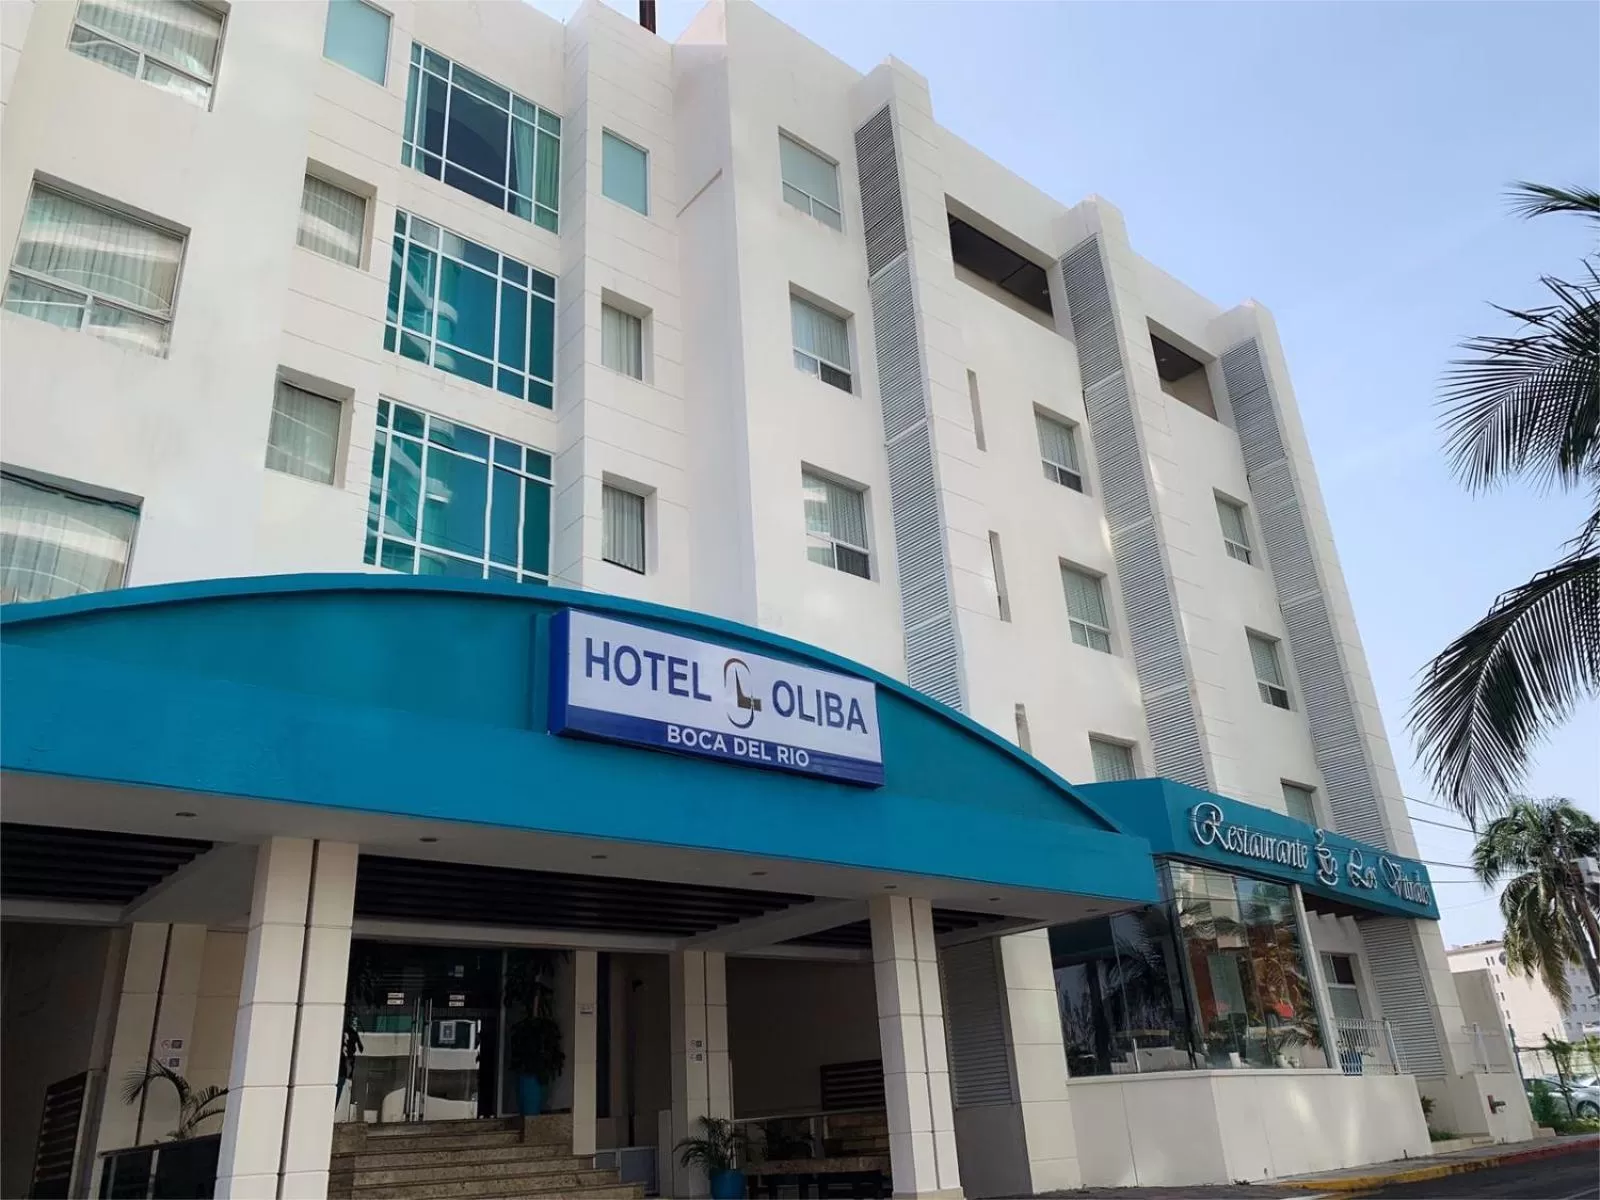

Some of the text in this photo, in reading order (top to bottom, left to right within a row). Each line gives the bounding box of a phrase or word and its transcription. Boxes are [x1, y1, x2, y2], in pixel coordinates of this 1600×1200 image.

[585, 637, 868, 734] HOTEL OLIBA
[667, 724, 811, 768] BOCA DEL RIO
[1191, 801, 1309, 869] Restaurante
